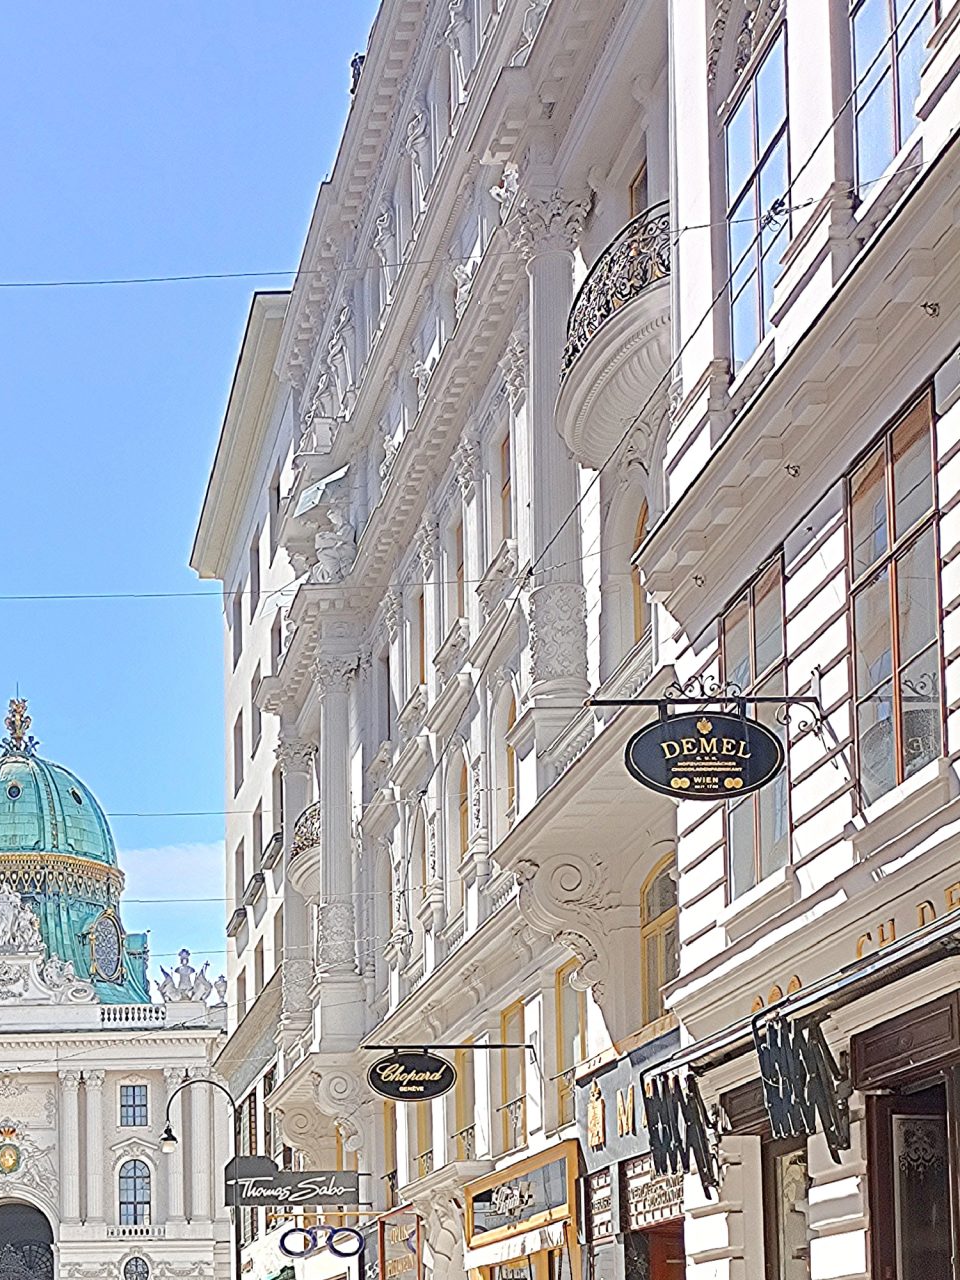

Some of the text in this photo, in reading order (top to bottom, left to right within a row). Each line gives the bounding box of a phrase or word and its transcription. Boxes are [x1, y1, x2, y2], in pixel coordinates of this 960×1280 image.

[660, 737, 752, 760] DEMEL
[693, 776, 719, 784] WIEN
[376, 1062, 448, 1086] Chopard
[226, 1176, 356, 1202] Thomas Sabo
